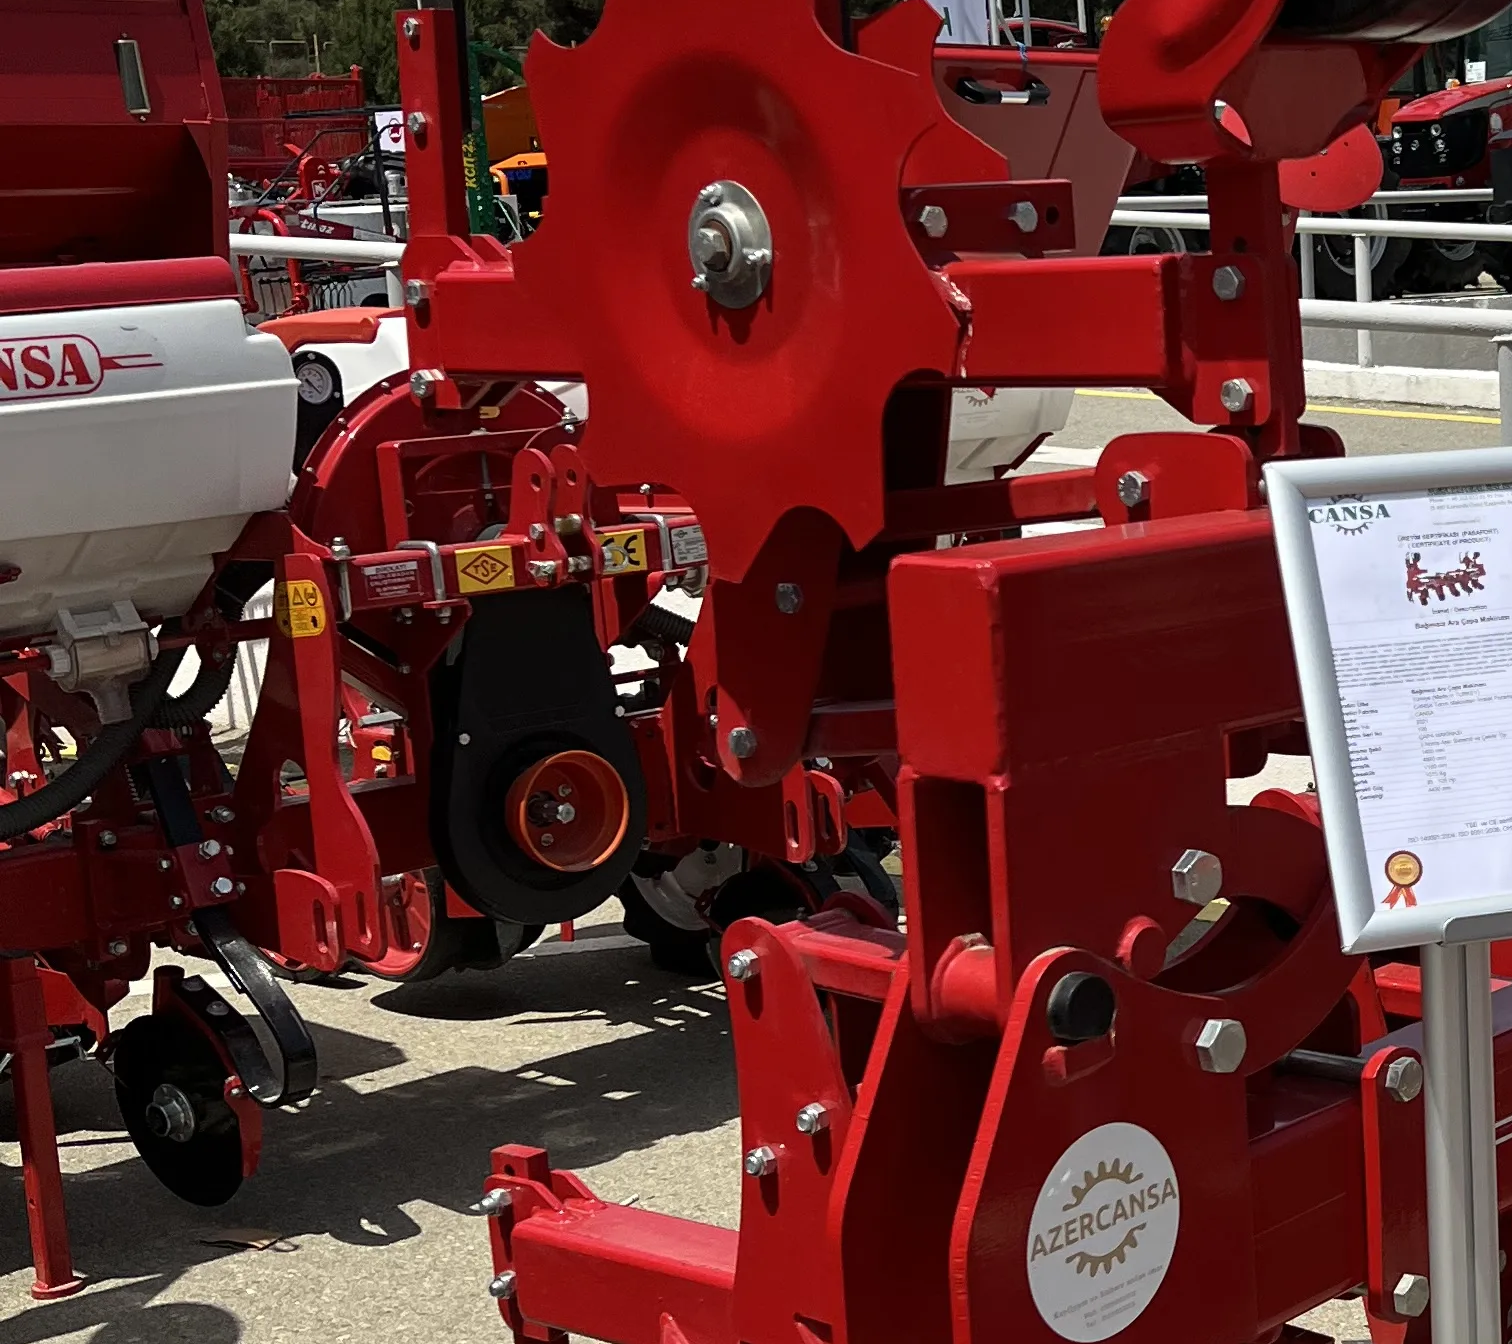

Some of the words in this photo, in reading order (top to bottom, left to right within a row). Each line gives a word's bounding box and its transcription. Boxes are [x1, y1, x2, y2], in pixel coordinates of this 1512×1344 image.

[1308, 503, 1391, 524] CANSA
[472, 557, 497, 578] TSE
[1030, 1177, 1177, 1262] AZERCANSA
